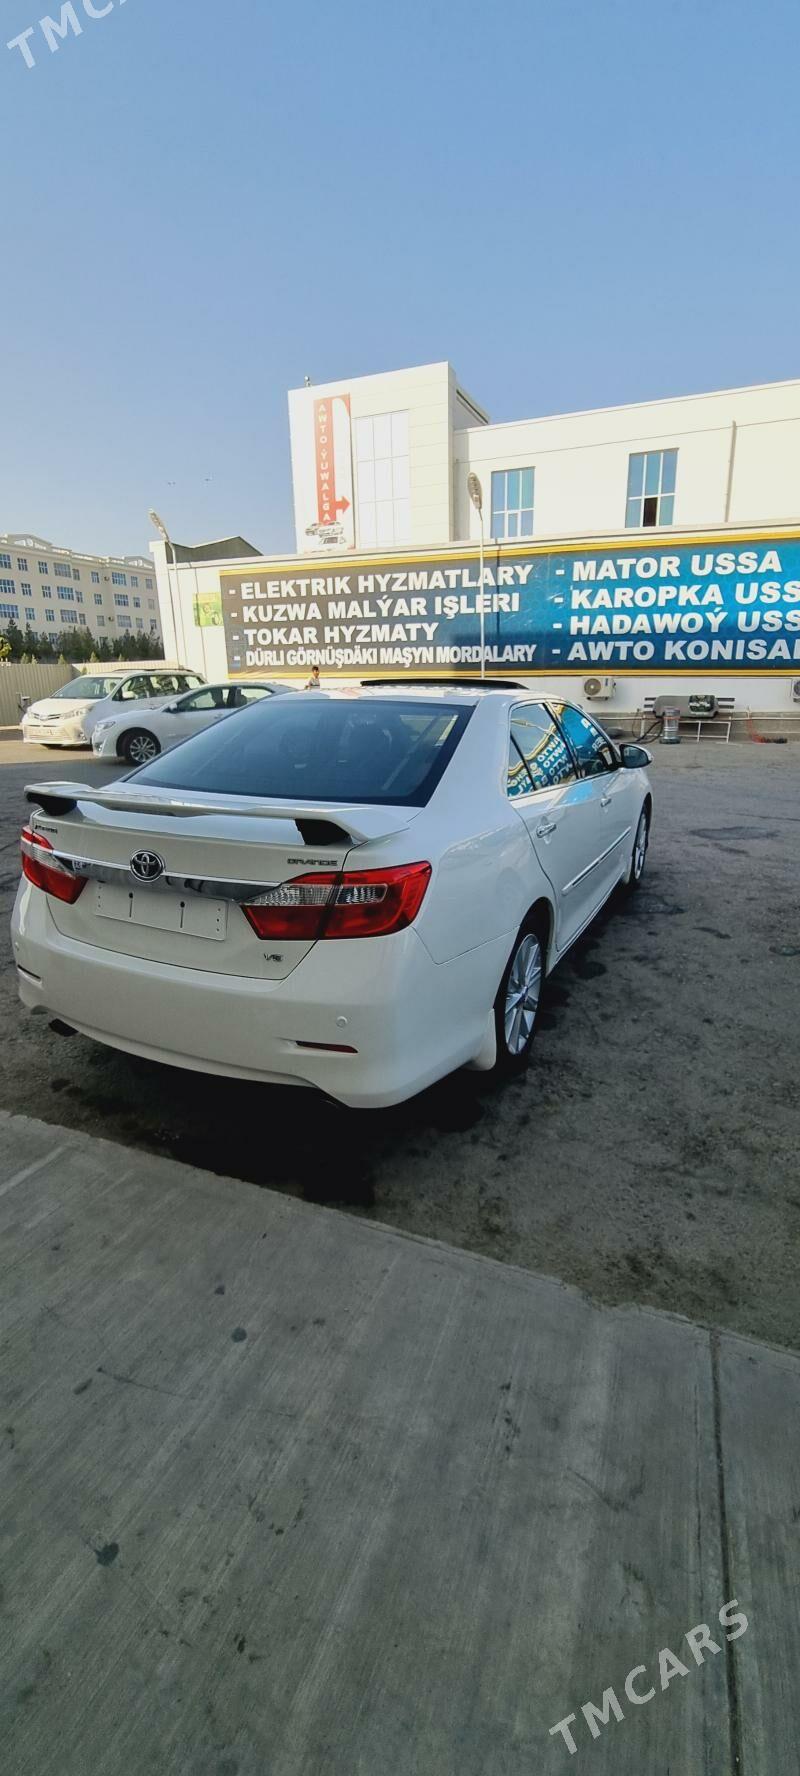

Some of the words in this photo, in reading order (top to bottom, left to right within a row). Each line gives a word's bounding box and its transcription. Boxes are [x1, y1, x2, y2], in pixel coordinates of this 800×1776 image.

[318, 403, 329, 444] AWTO
[572, 556, 681, 581] MATOR
[691, 550, 783, 576] USSA
[240, 576, 352, 600] ELEKTRIK
[358, 564, 534, 593] HYZMATLARY
[242, 602, 322, 623] KUZWA
[328, 595, 428, 620] MALÝAR
[434, 592, 520, 619] IŞLERI
[571, 584, 724, 609] KAROPKA
[244, 626, 319, 646] TOKAR
[324, 622, 439, 644] HYZMATY
[570, 607, 728, 635] HADAWOÝ
[245, 647, 285, 667] DÜRLI
[286, 645, 377, 669] GÖRNÜŞDÄKI
[379, 646, 434, 668] MAŞYN
[436, 644, 537, 665] MORDALARY
[567, 640, 655, 661] AWTO
